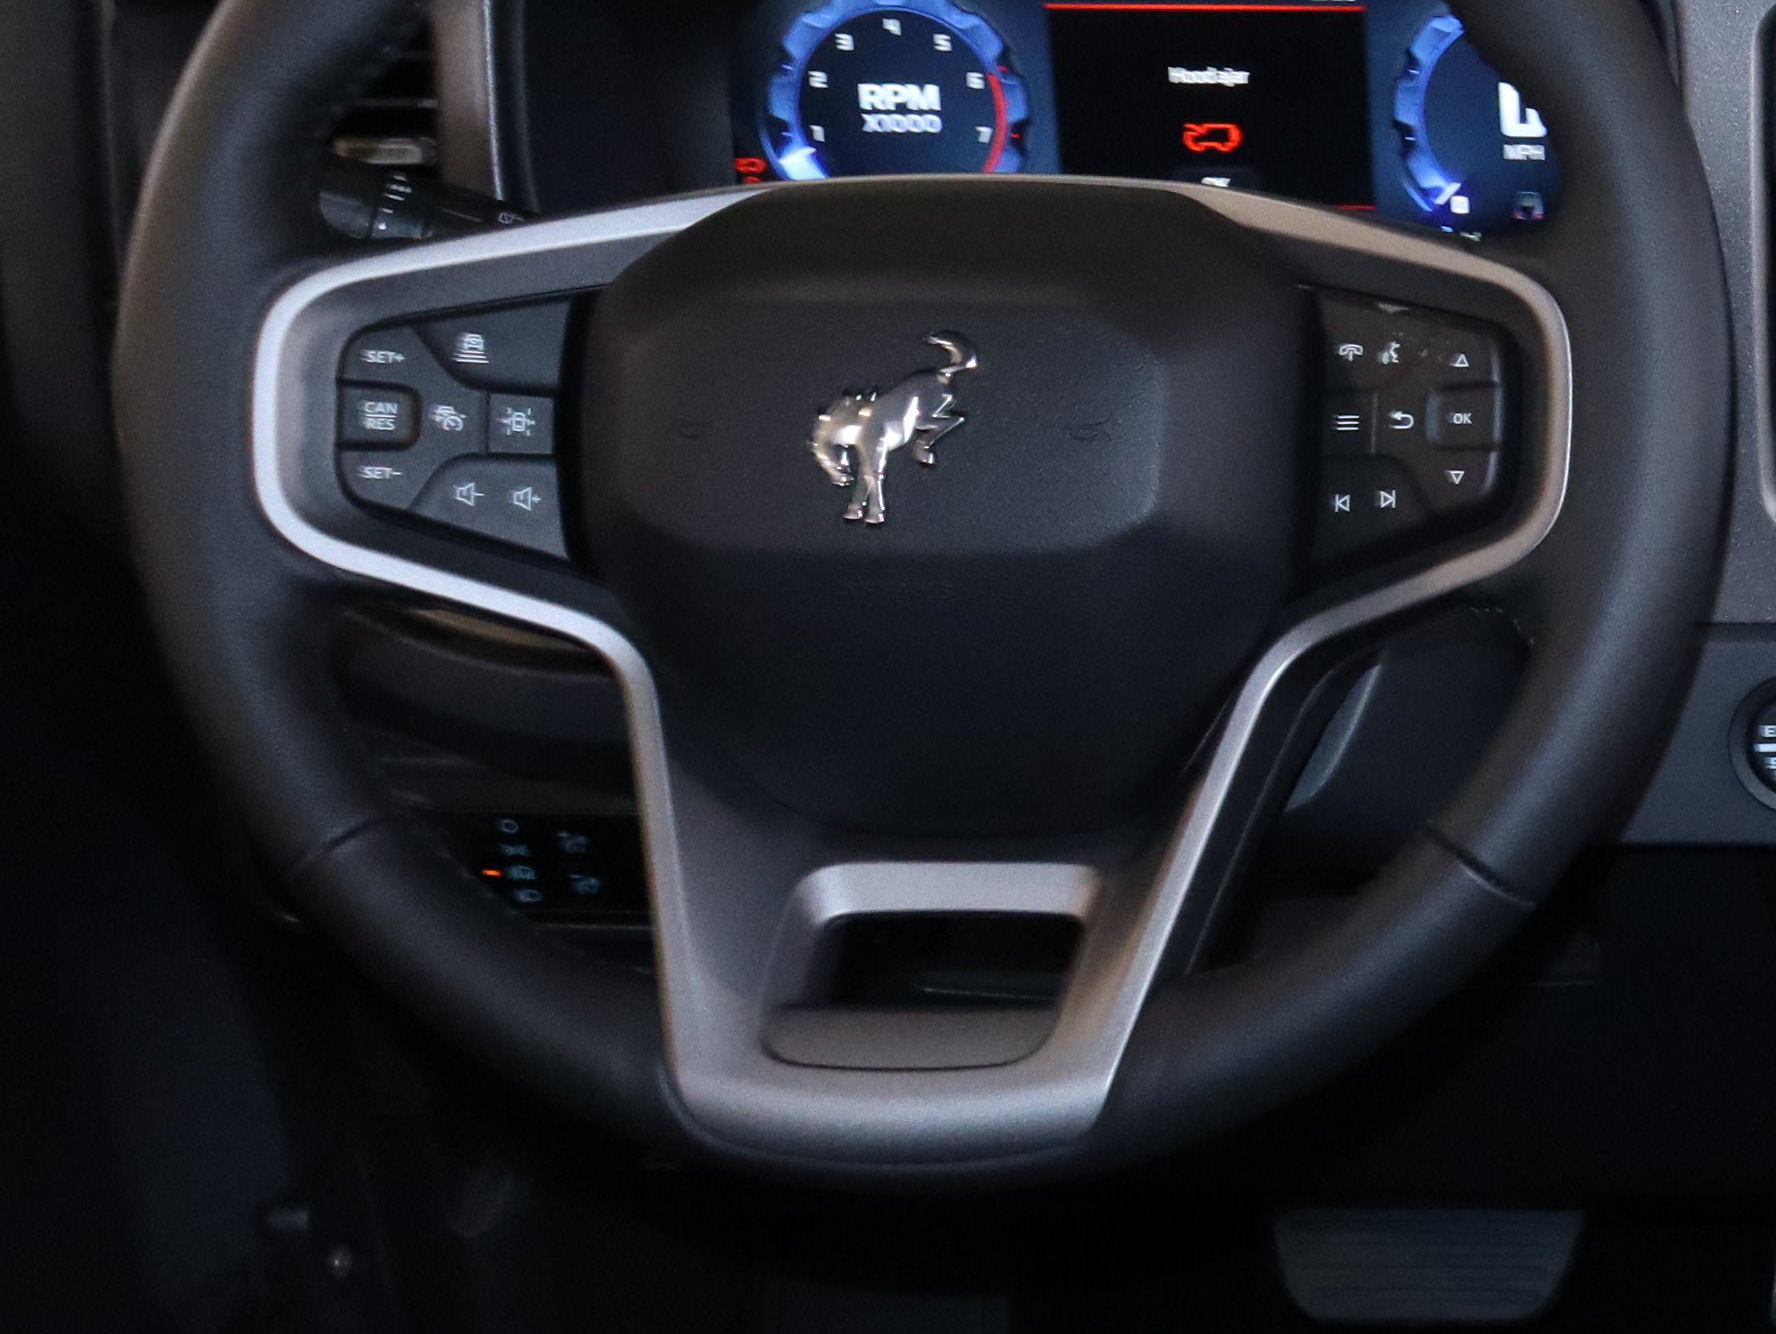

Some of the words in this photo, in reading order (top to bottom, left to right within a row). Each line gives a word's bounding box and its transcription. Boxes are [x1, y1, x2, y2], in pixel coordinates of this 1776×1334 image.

[835, 33, 854, 51] 3
[933, 33, 952, 51] 5
[808, 71, 829, 88] 2
[966, 71, 985, 89] 6
[857, 82, 941, 112] RPM
[810, 124, 826, 143] 1
[976, 126, 992, 144] 7
[1502, 144, 1546, 161] MPH
[362, 401, 398, 414] CAN
[364, 418, 396, 431] RES
[1451, 412, 1473, 425] OK
